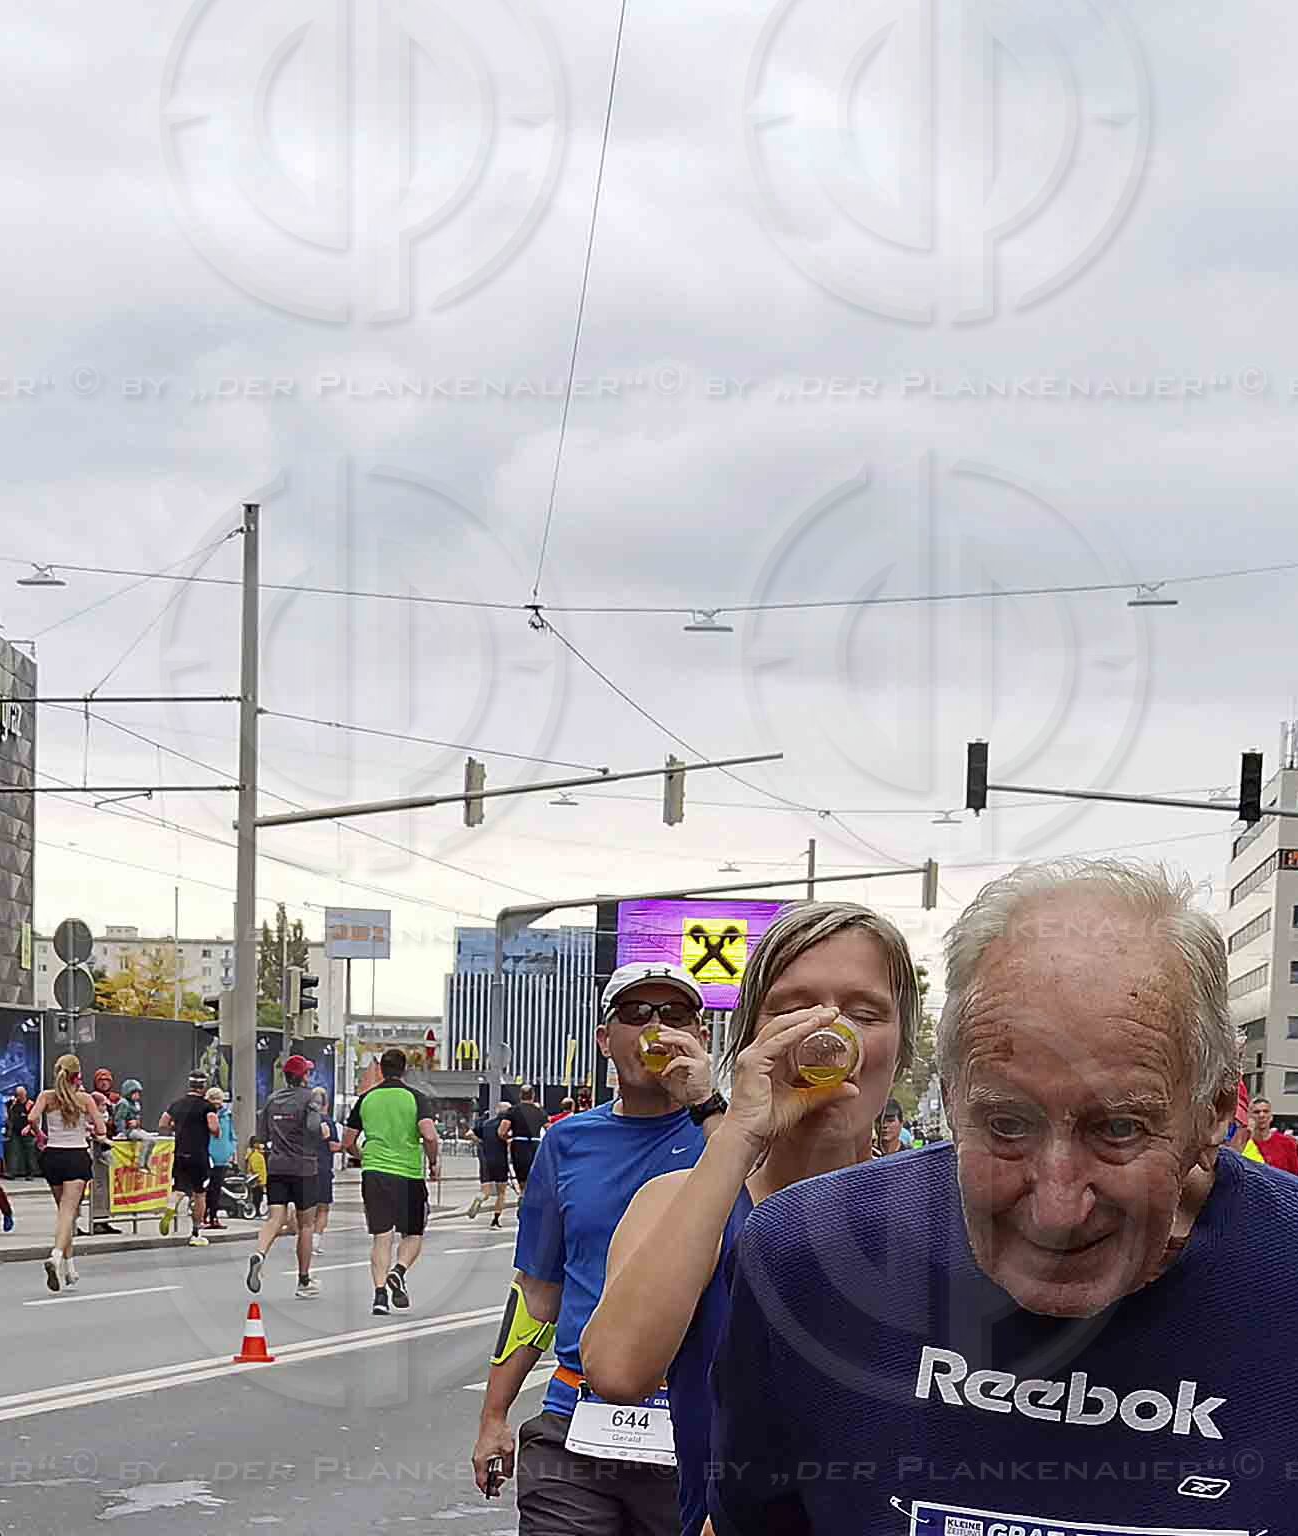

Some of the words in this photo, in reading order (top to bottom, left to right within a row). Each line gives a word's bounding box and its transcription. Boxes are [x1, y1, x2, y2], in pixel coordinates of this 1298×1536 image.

[914, 1344, 1228, 1440] Reebok
[611, 1410, 650, 1430] 644
[611, 1432, 642, 1444] Gerald
[947, 1519, 981, 1530] KLEINE
